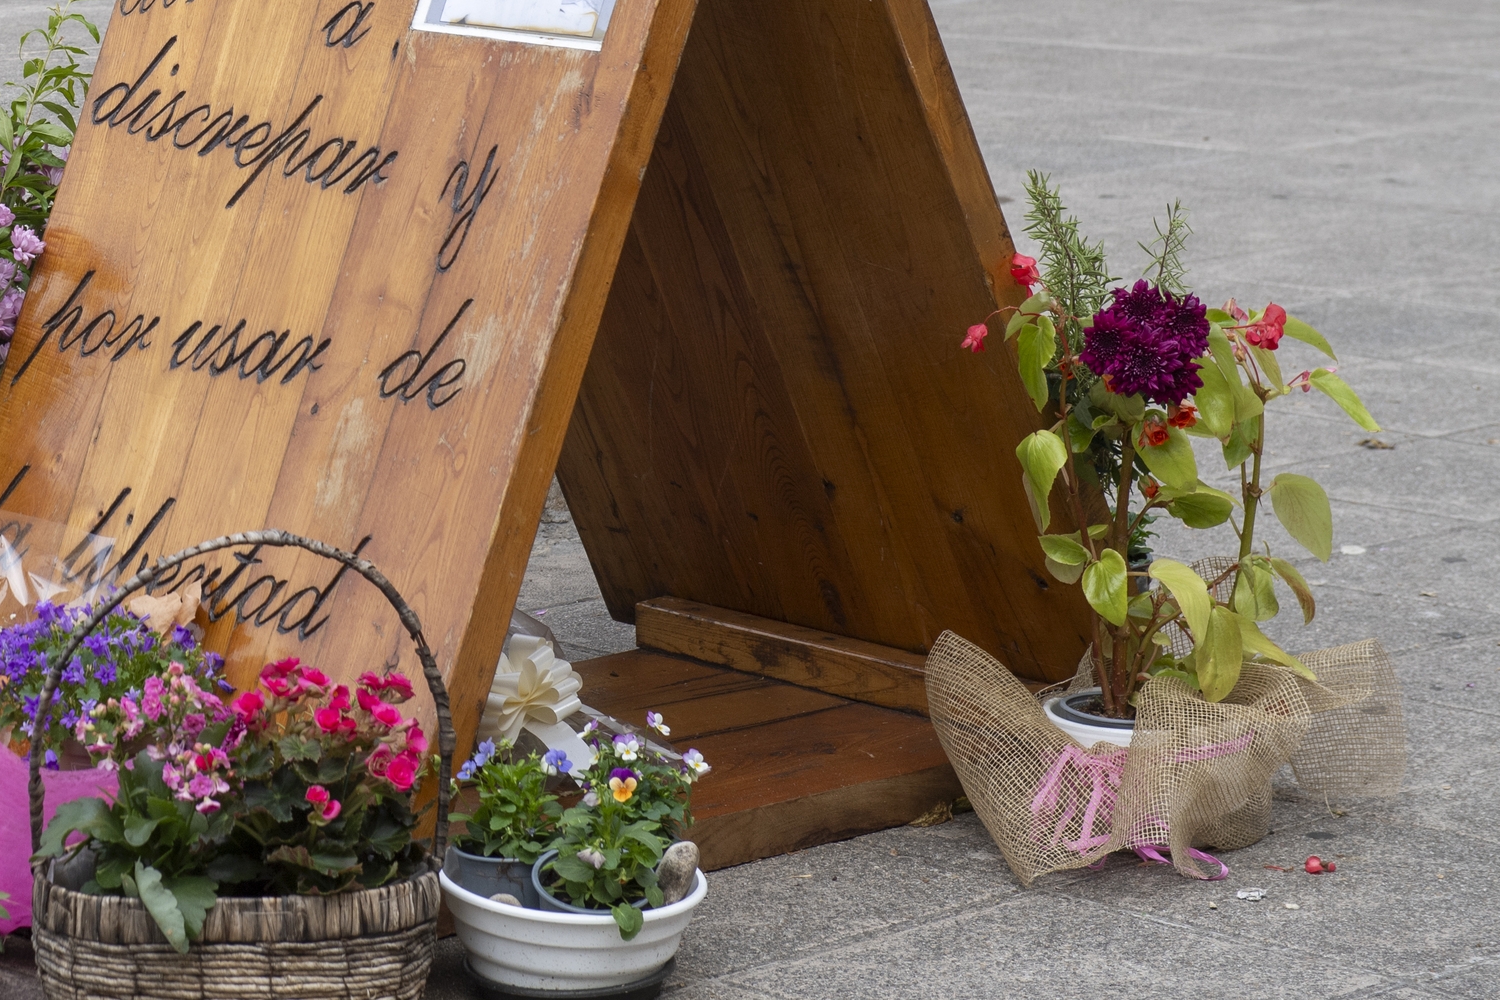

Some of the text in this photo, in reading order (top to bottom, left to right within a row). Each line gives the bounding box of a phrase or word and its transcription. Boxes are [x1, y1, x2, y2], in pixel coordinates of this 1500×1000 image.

[322, 0, 371, 49] a
[90, 35, 500, 273] discrepar y
[9, 269, 474, 411] por usar de
[61, 486, 372, 641] libertad
